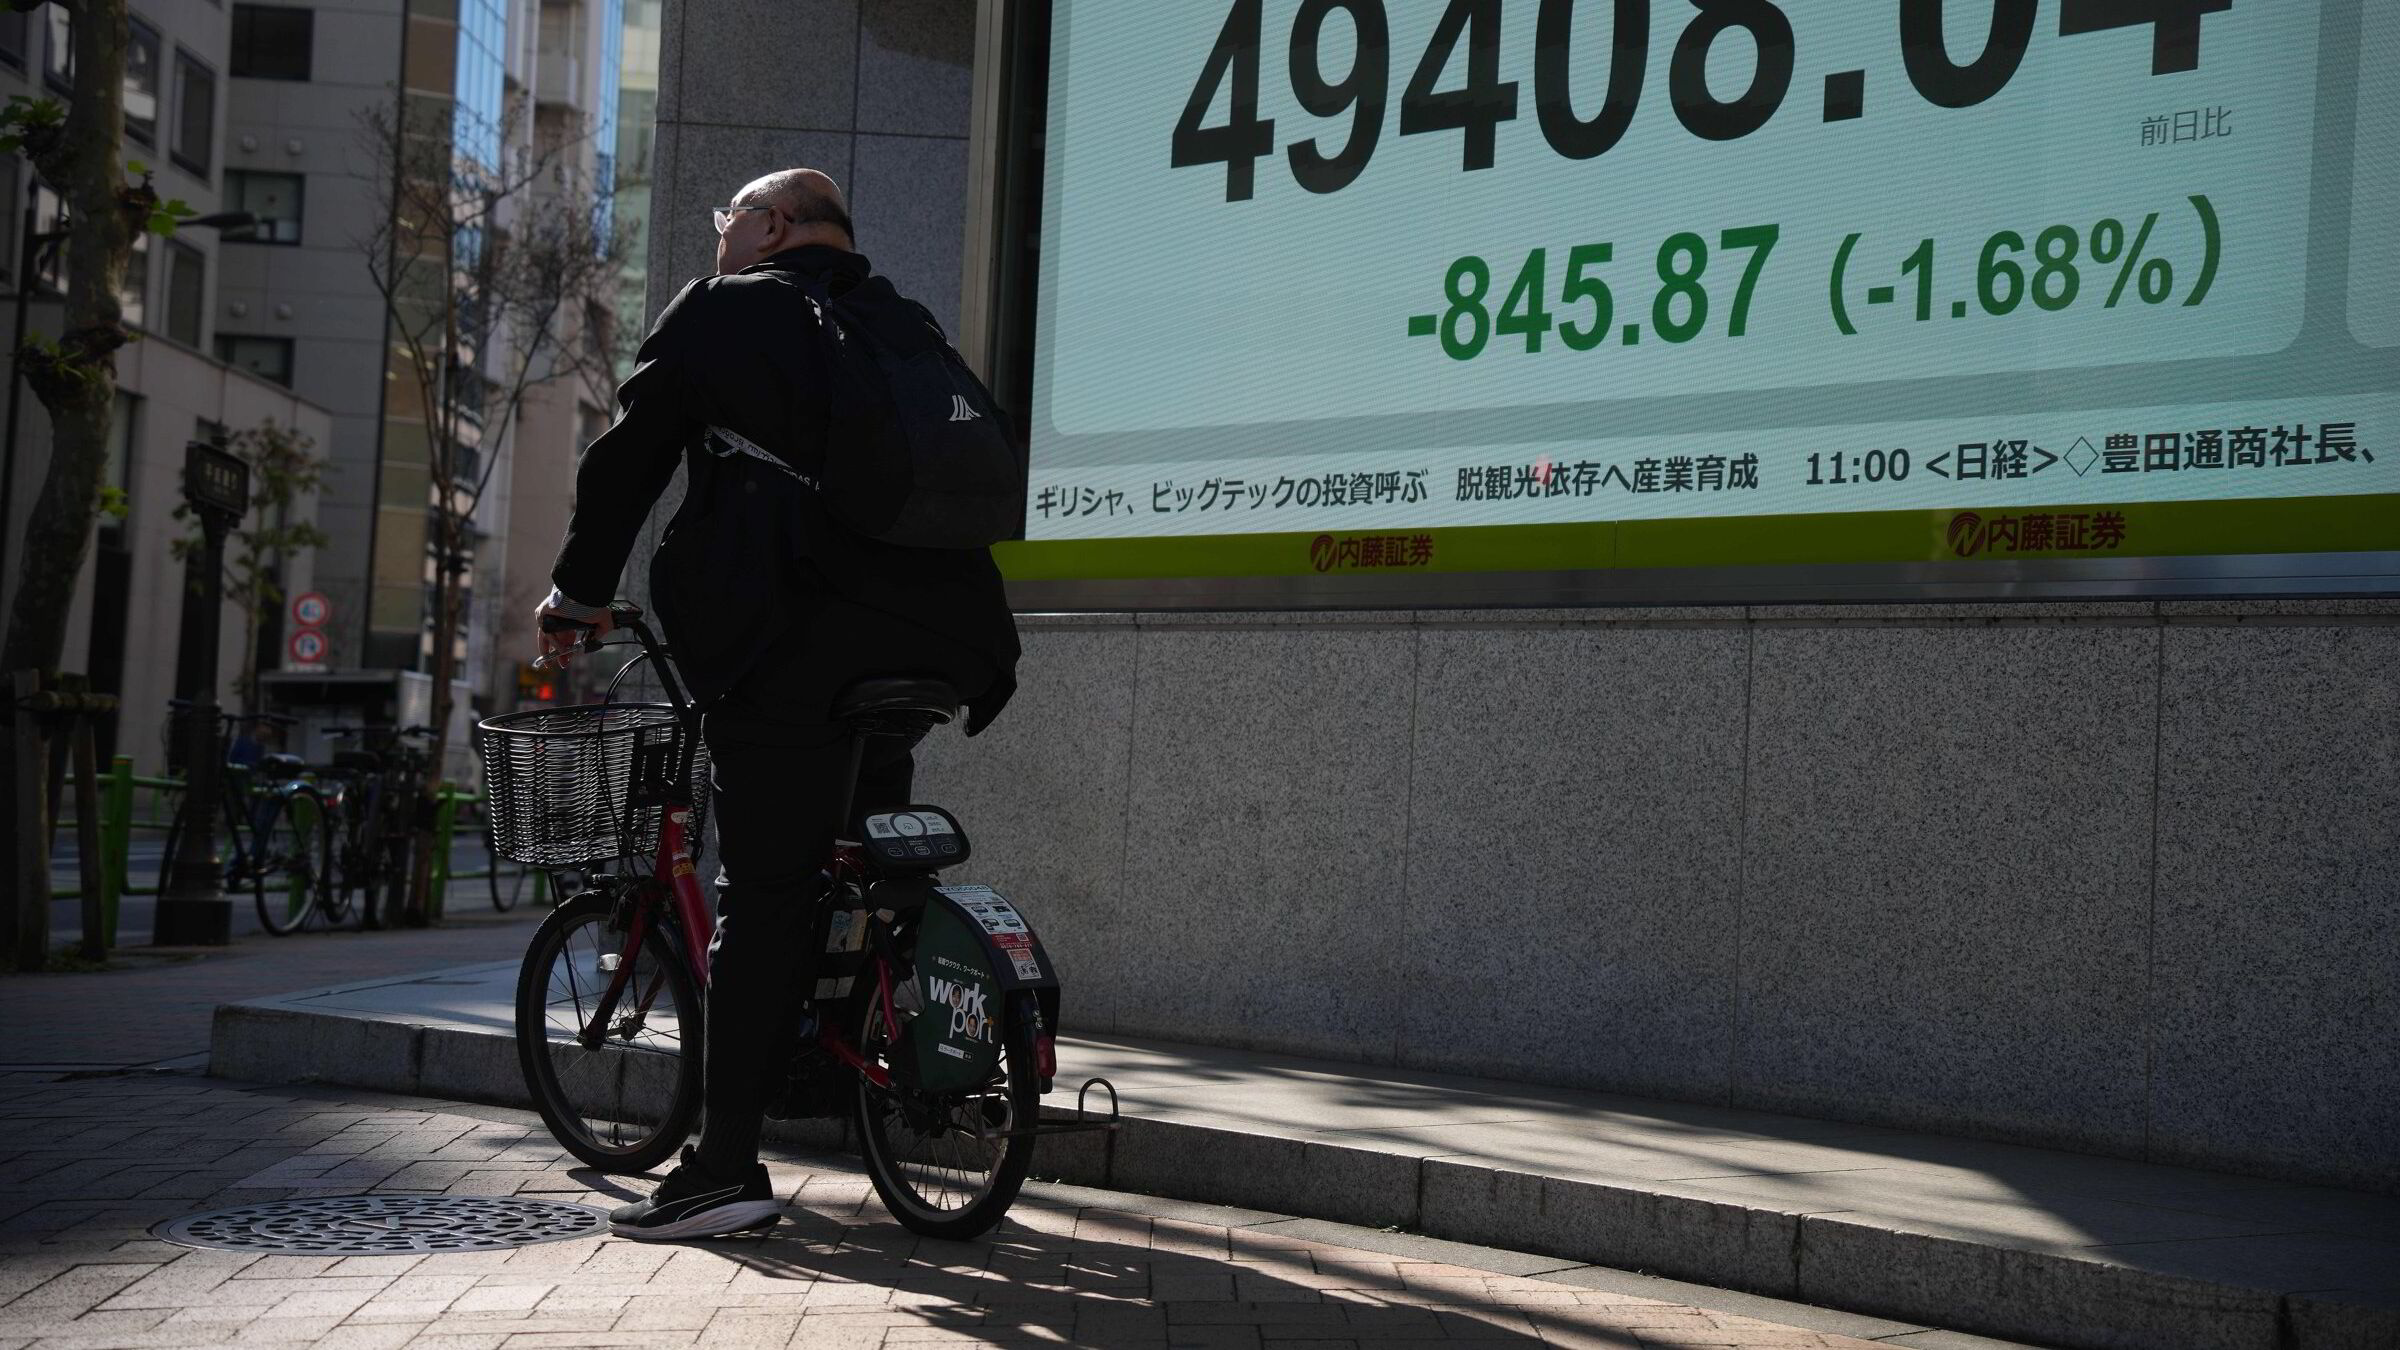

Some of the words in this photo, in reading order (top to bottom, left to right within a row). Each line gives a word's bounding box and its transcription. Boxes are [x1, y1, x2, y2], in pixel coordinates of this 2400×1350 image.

[2140, 105, 2232, 146] 前日比
[1407, 222, 1780, 361] -845.87
[1828, 193, 2221, 335] (-1.68%)
[1036, 468, 1428, 518] ギリシャ、ビッグテックの投資呼ぶ
[1455, 452, 1759, 501] 脱観光依存へ産業育成
[1806, 448, 1910, 485] 11:00
[1337, 533, 1434, 569] 内藤証券
[1987, 510, 2126, 553] 内藤証券
[929, 975, 987, 1019] work
[949, 1006, 993, 1044] port
